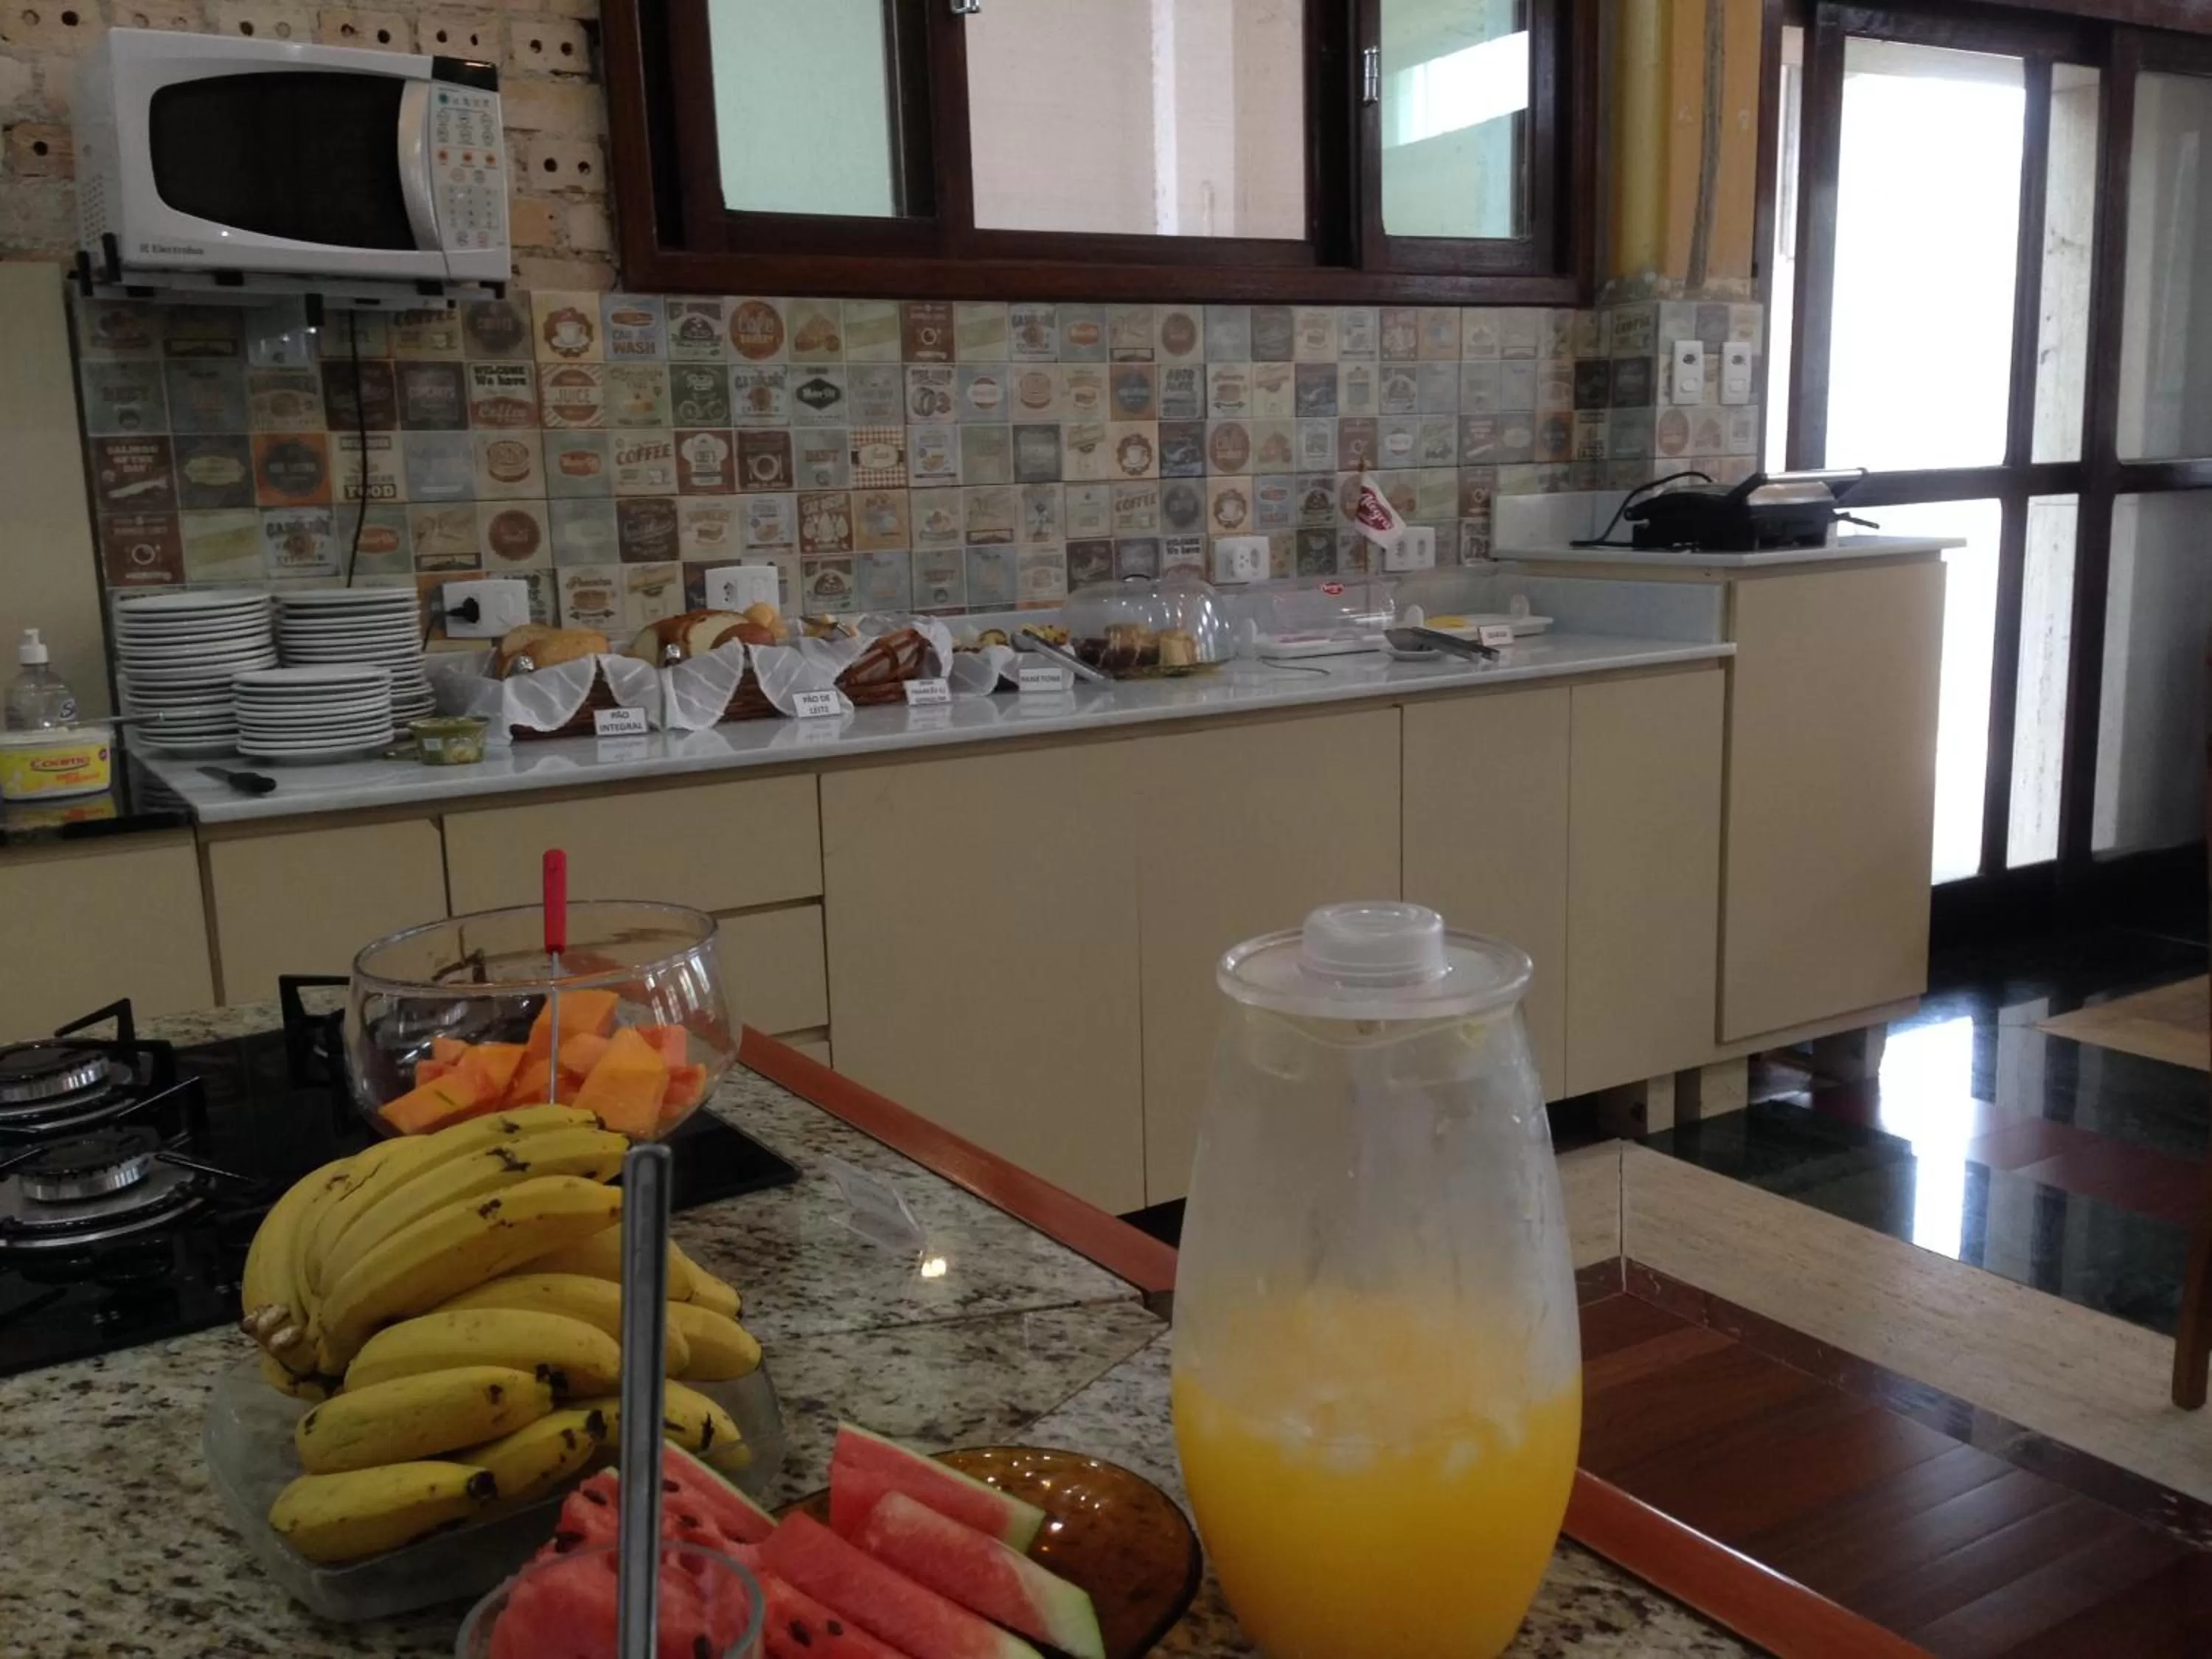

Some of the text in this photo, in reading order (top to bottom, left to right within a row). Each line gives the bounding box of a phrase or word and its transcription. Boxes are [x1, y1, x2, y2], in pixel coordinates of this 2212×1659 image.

[612, 341, 655, 355] WASH
[473, 366, 524, 375] WELCOME
[475, 375, 526, 386] We have
[555, 389, 591, 403] JUICE
[616, 443, 672, 466] COFFEE
[611, 710, 630, 720] PÃO
[599, 723, 644, 732] INTEGRAL
